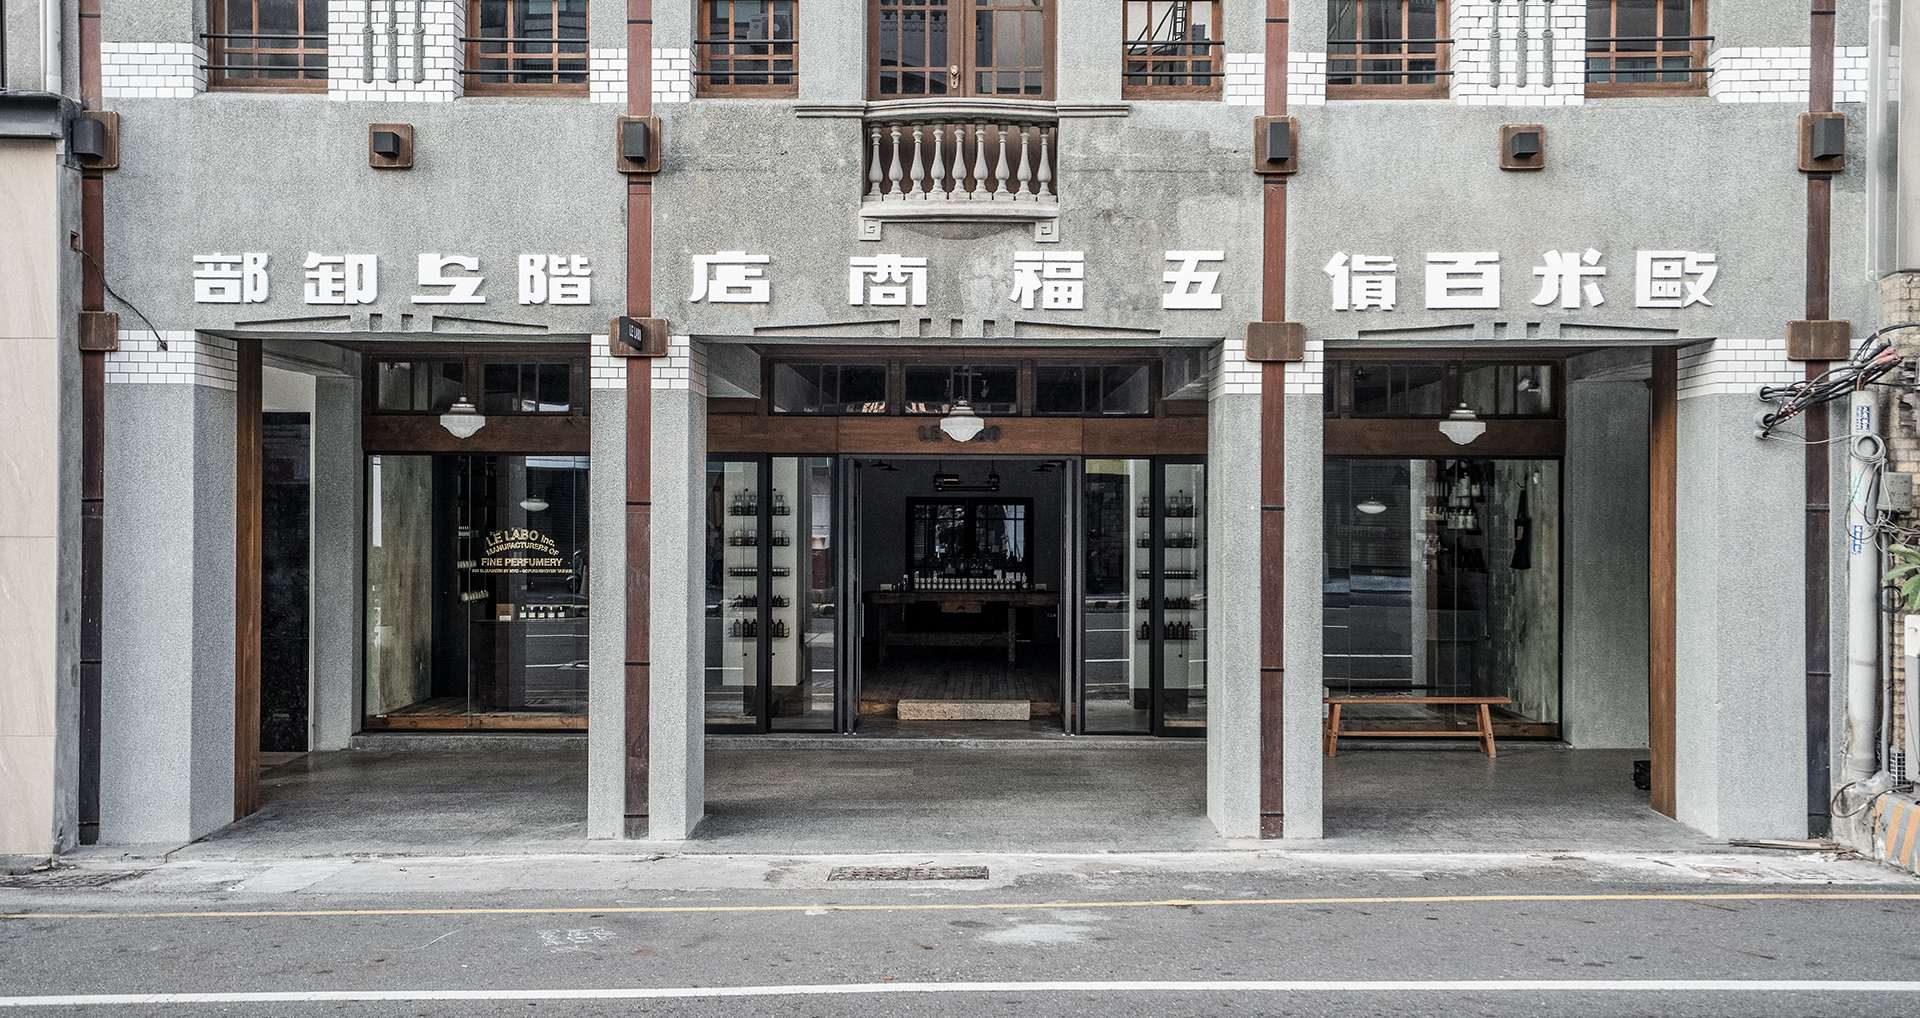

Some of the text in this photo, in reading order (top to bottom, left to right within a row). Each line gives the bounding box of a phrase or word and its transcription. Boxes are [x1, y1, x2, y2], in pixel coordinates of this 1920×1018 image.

[486, 532, 502, 547] LE
[504, 529, 539, 541] LABO
[486, 541, 560, 556] MANUFACTURERS OF
[481, 557, 564, 567] FINE PERFUMERY
